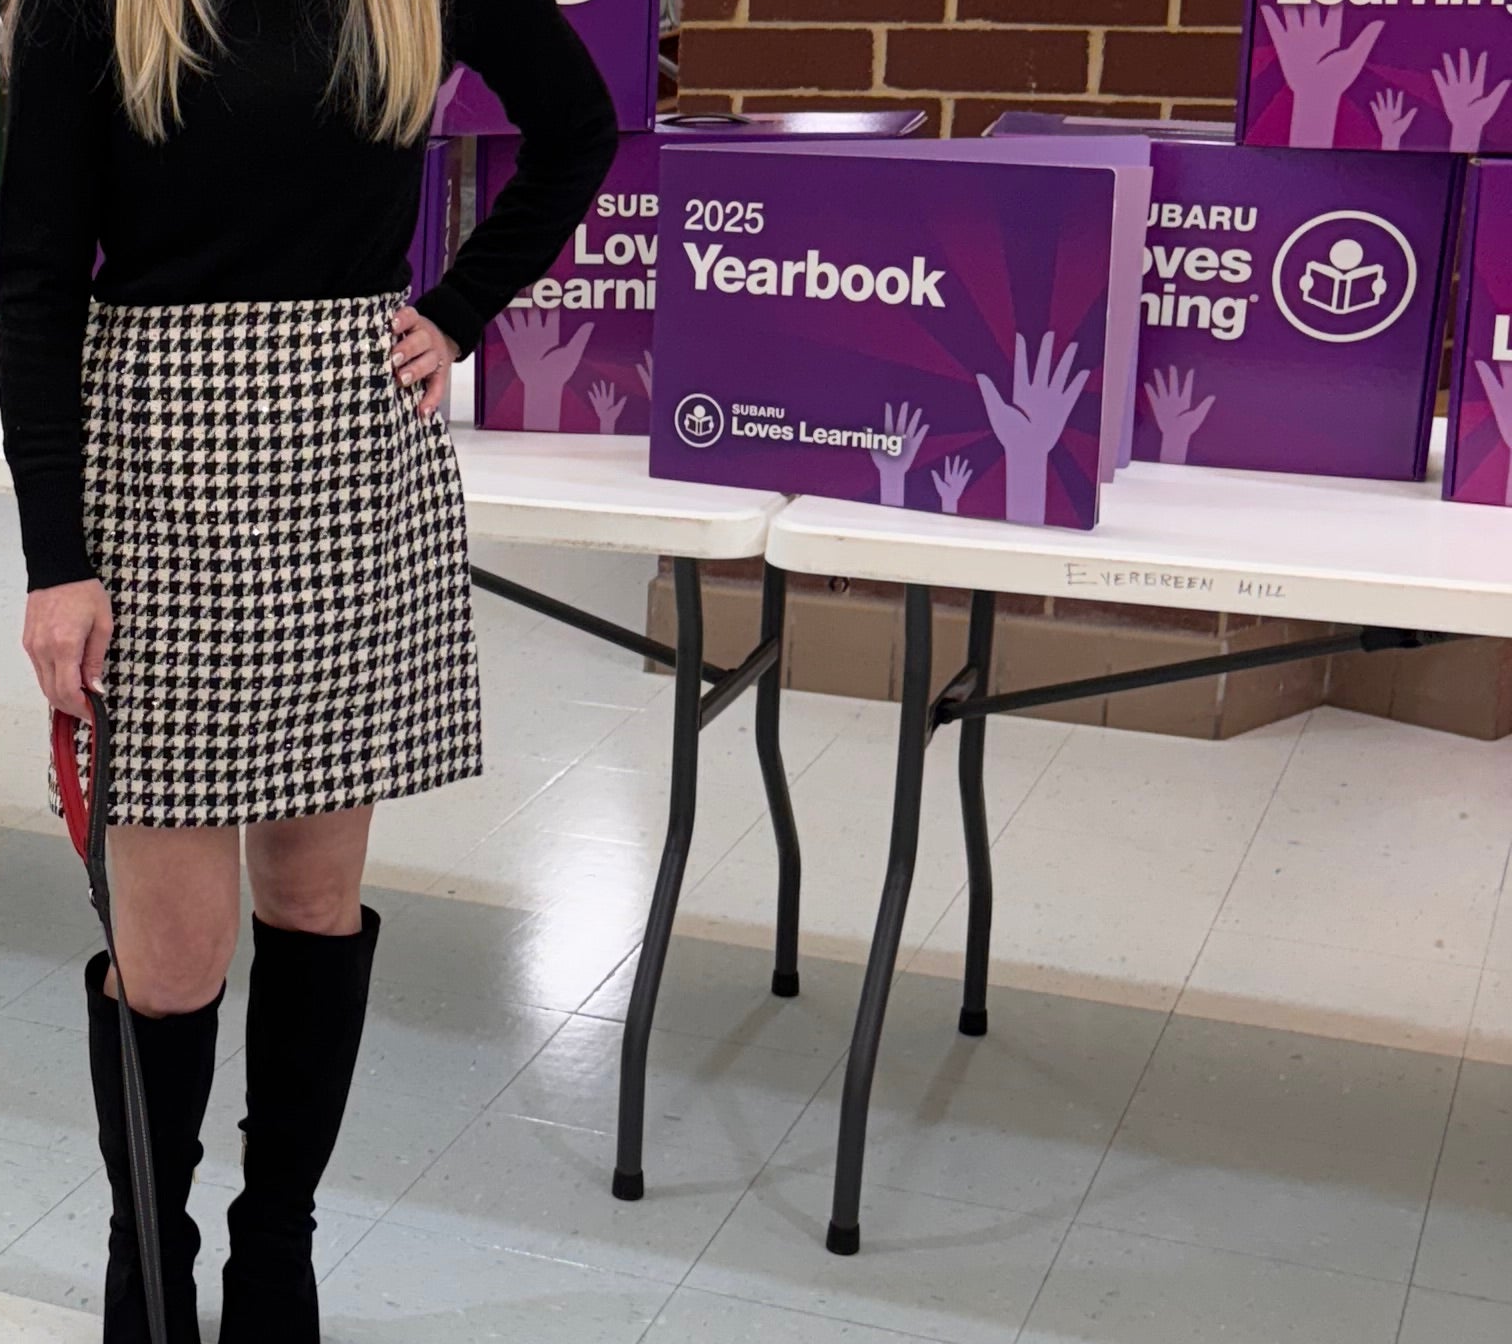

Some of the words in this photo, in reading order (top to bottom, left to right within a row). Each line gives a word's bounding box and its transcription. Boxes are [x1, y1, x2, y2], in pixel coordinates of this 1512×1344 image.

[596, 193, 659, 218] SUB
[684, 199, 765, 235] 2025
[574, 223, 658, 266] Lov
[682, 241, 947, 308] Yearbook
[1140, 283, 1248, 341] ning
[731, 403, 785, 419] SUBARU
[731, 416, 794, 441] Loves
[799, 421, 902, 456] Learning
[1238, 579, 1286, 598] MILL
